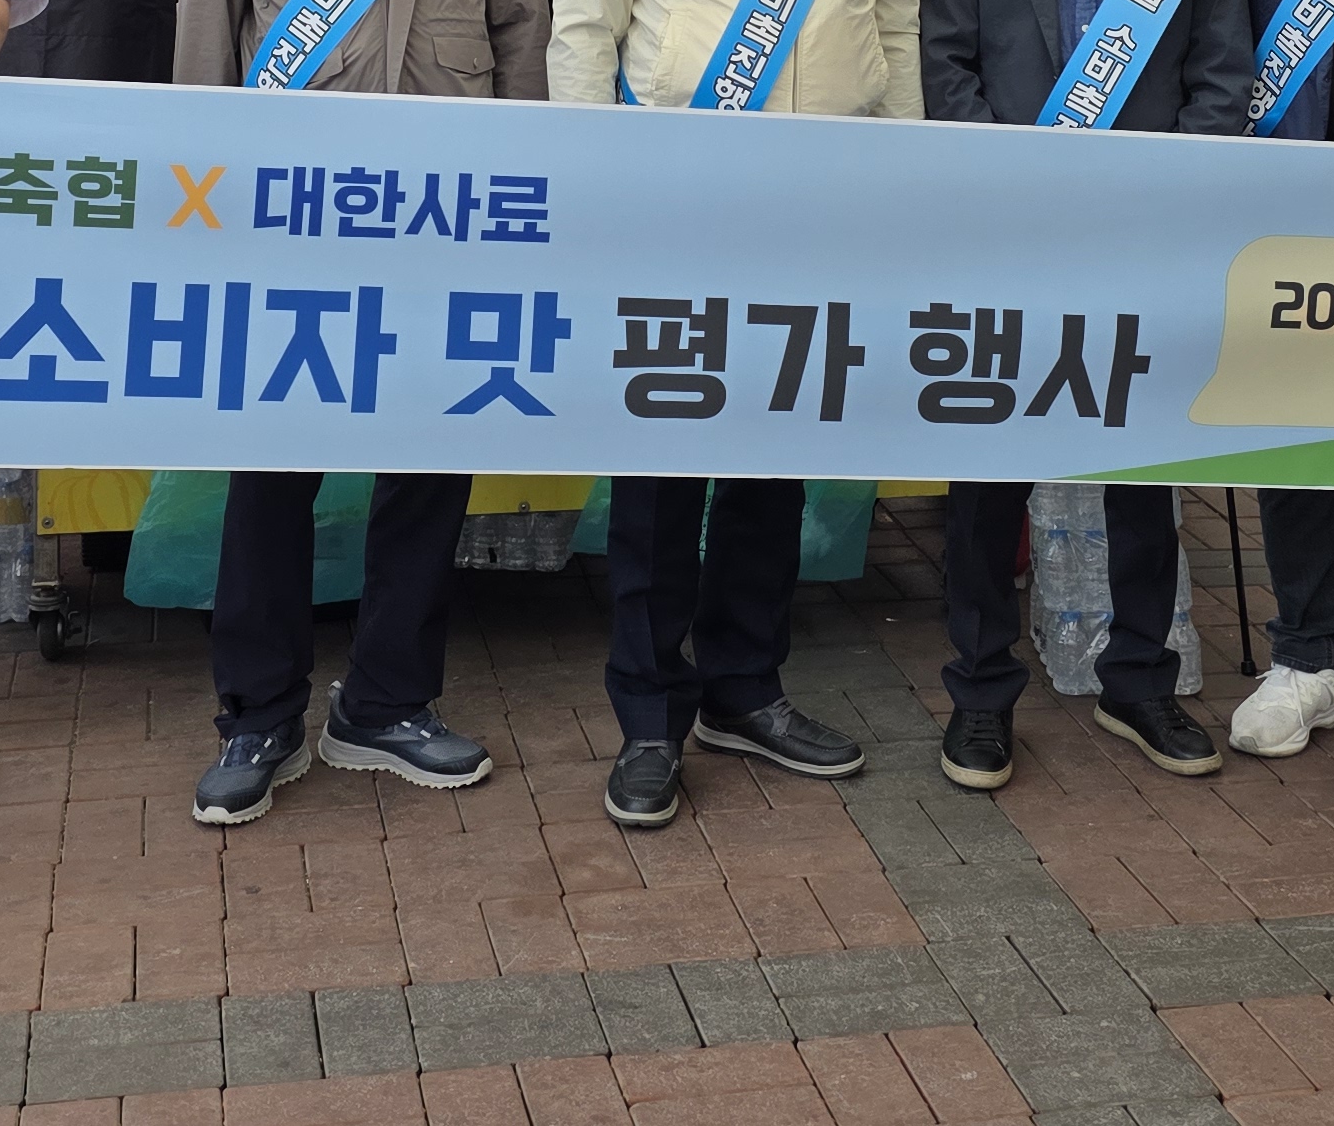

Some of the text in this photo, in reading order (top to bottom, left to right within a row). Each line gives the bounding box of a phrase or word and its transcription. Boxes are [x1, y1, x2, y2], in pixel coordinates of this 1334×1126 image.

[166, 163, 228, 230] X
[253, 166, 551, 244] 대한사료
[443, 291, 572, 417] 맛
[612, 296, 866, 422] 평가
[908, 301, 1151, 427] 행사
